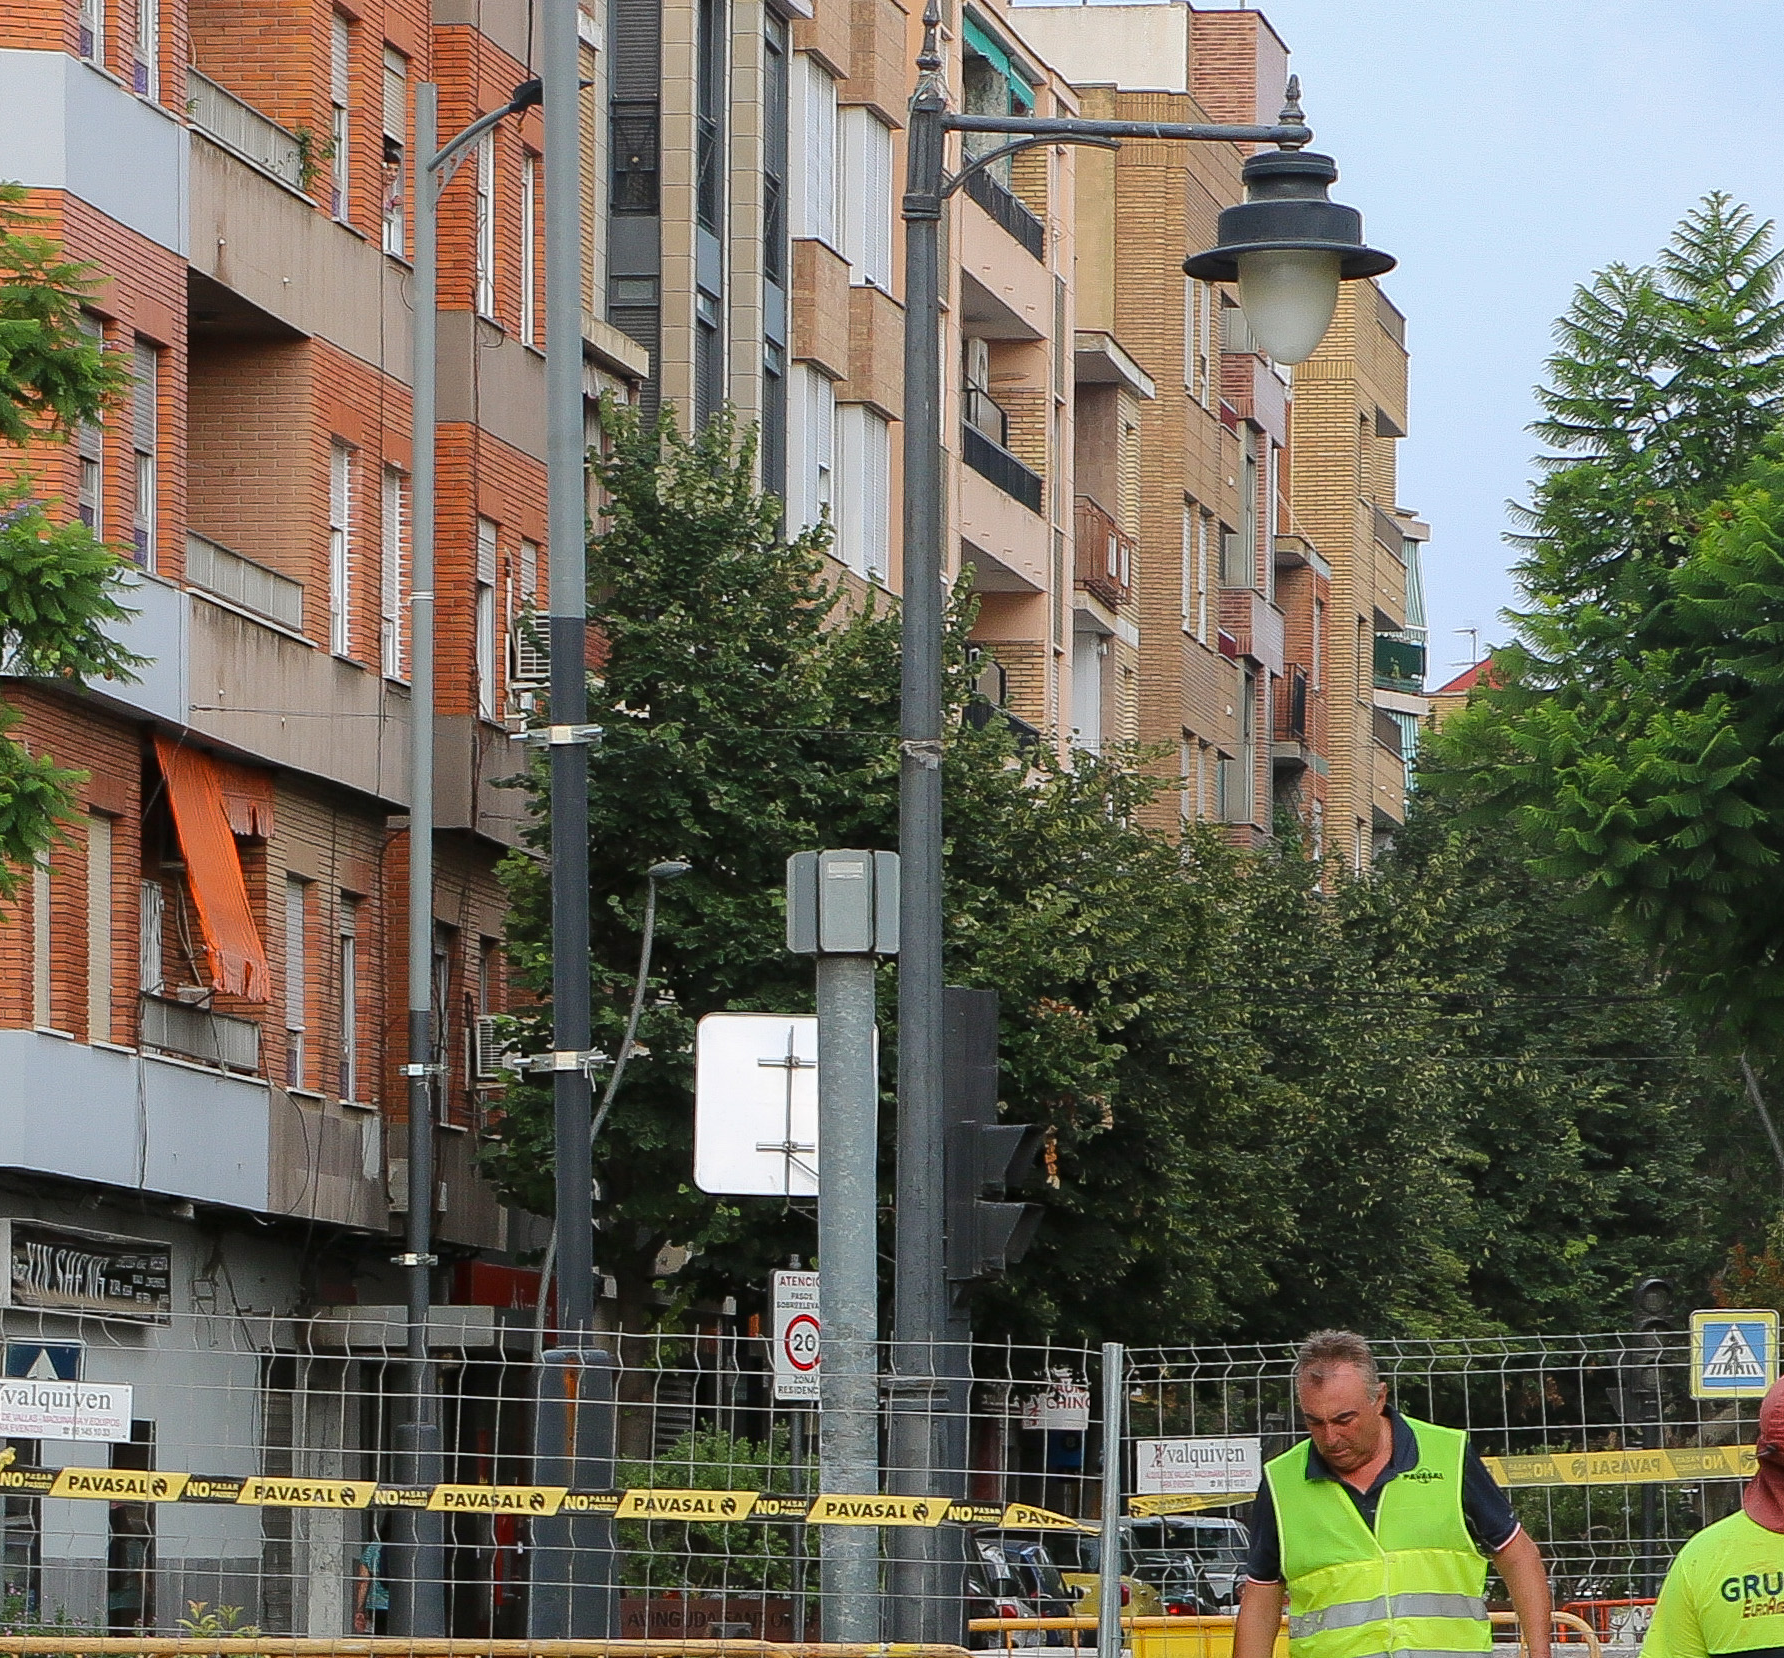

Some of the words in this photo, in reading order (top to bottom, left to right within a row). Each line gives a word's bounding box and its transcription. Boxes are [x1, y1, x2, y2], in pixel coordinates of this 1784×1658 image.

[794, 1333, 816, 1352] 20
[793, 1375, 815, 1384] ZONA
[5, 1384, 111, 1413] valquiven
[777, 1386, 820, 1395] RESIDENC
[1167, 1443, 1246, 1468] valquiven
[68, 1475, 148, 1494] PAVASAL
[186, 1480, 210, 1497] NO
[254, 1485, 336, 1503] PAVASAL
[375, 1489, 399, 1506] NO
[443, 1492, 524, 1510] PAVASAL
[565, 1495, 589, 1511] NO
[633, 1497, 716, 1514] PAVASAL
[756, 1499, 780, 1516] NO
[825, 1502, 907, 1518] PAVASAL
[949, 1505, 973, 1521] NO
